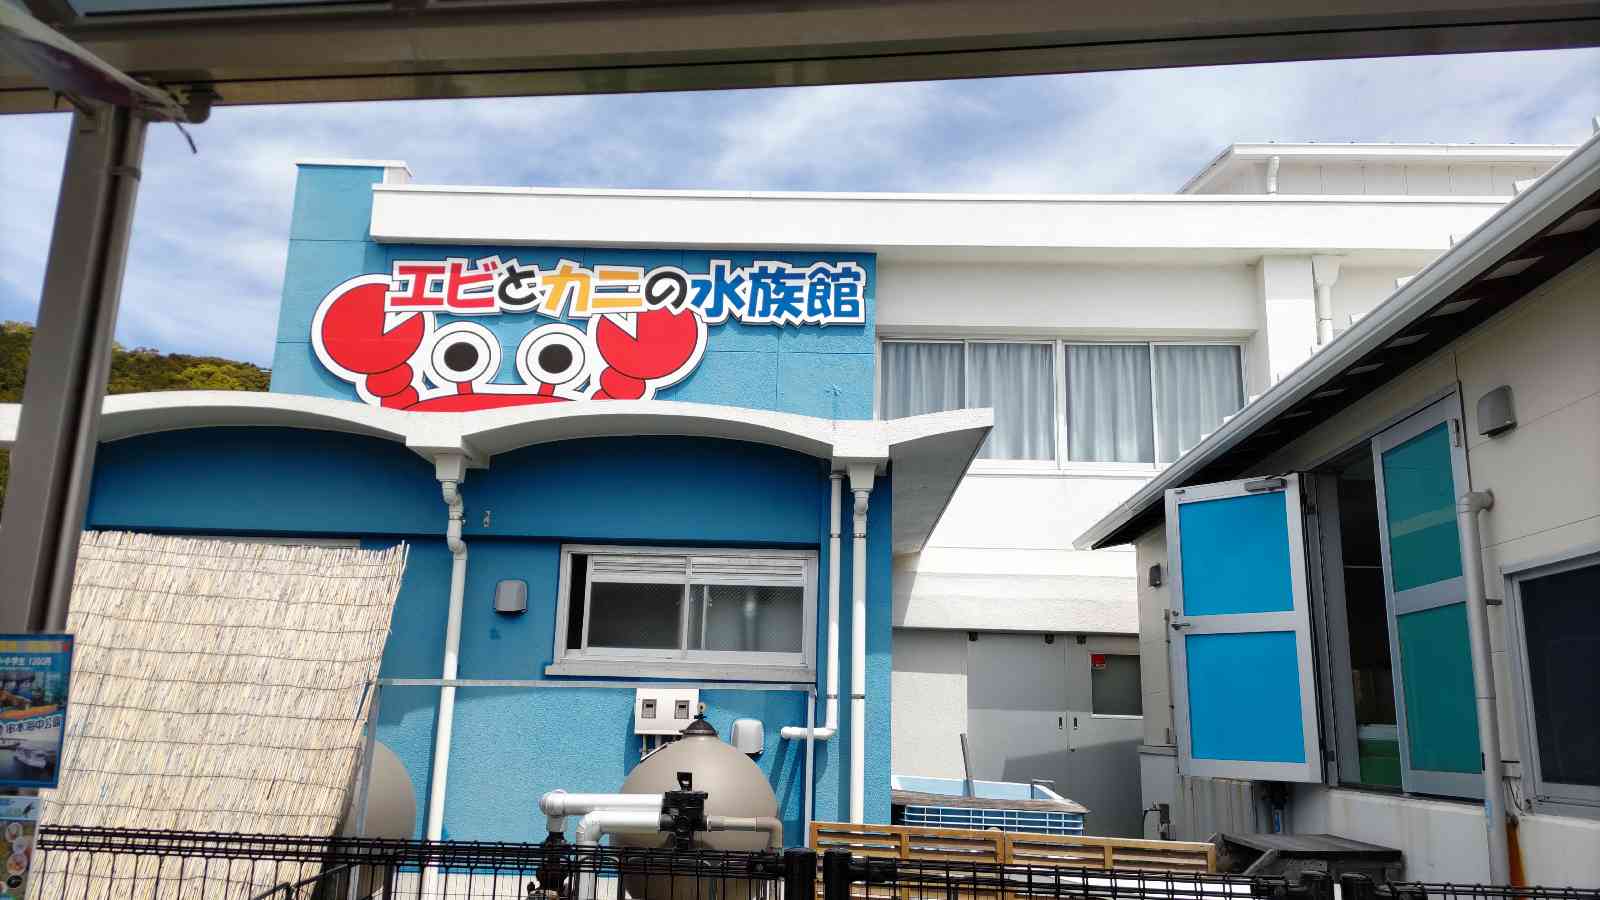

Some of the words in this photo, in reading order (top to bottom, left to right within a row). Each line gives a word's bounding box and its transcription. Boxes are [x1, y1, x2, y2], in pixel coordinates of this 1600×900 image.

[390, 260, 862, 318] エビとカニの水族館
